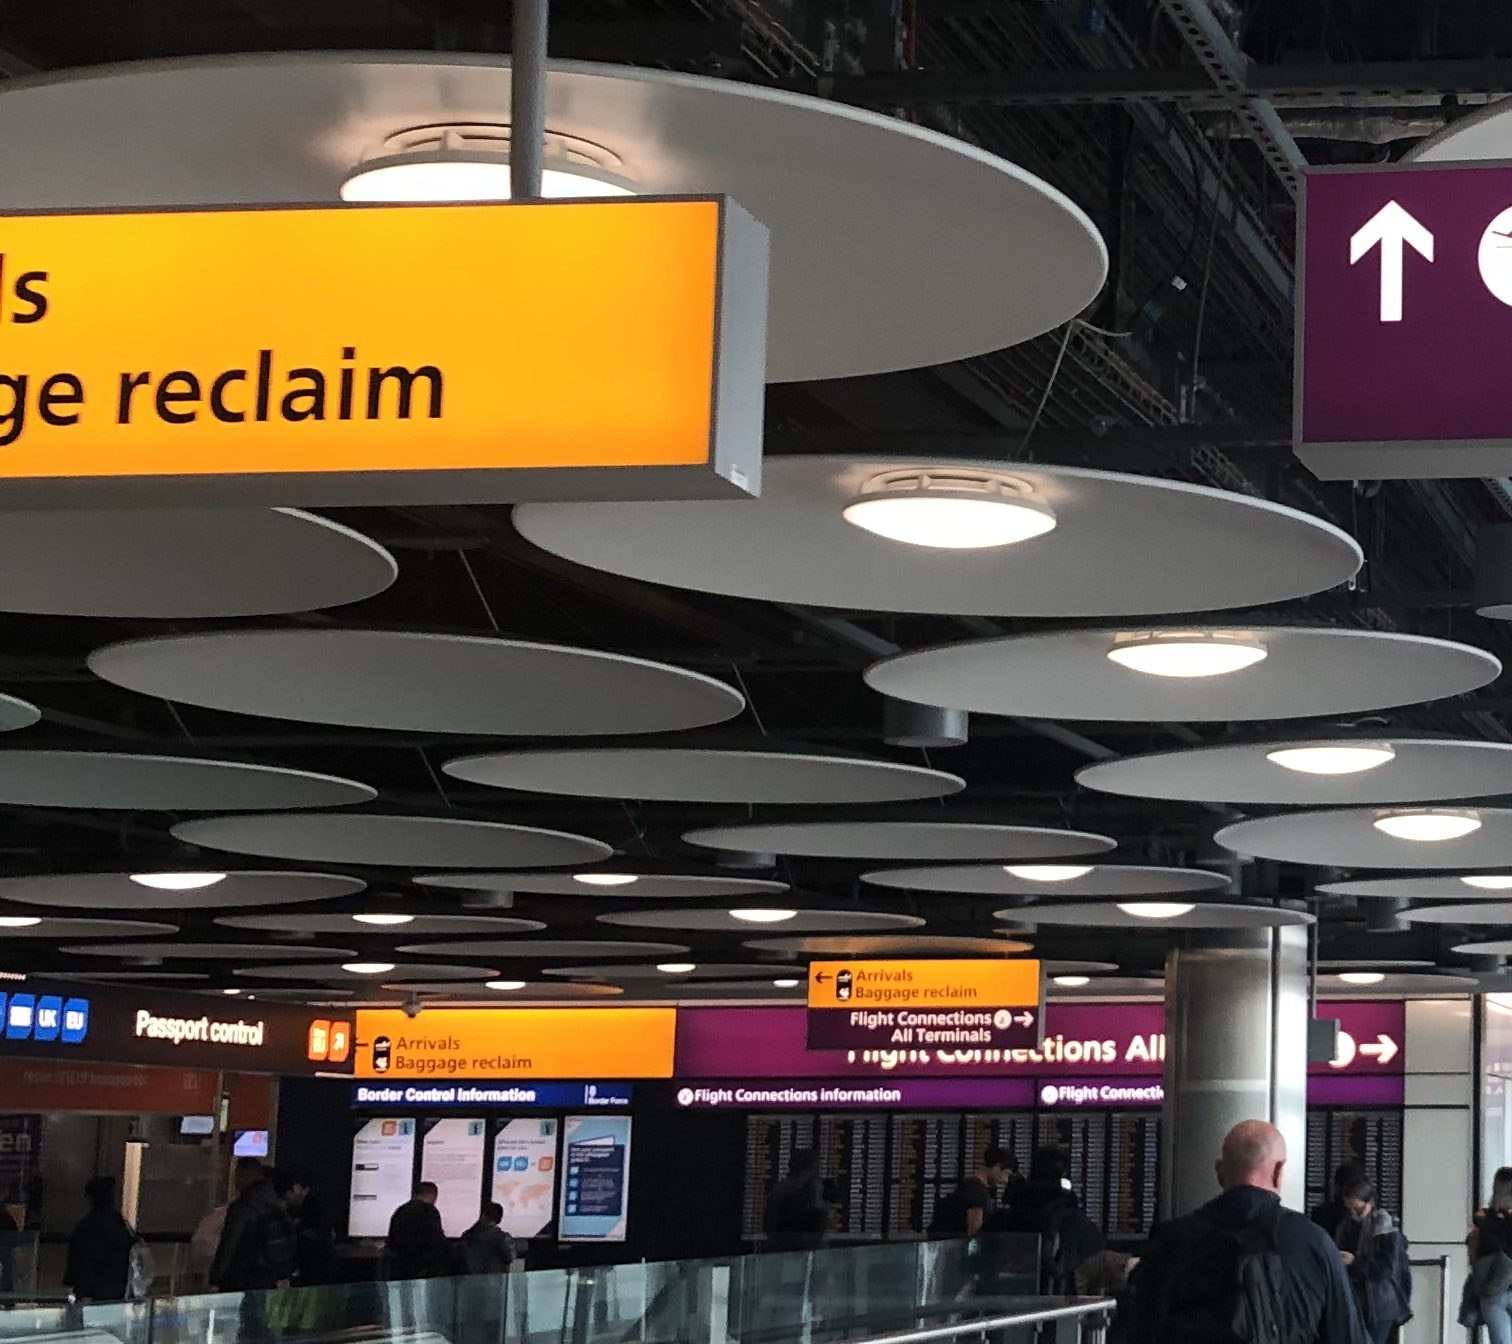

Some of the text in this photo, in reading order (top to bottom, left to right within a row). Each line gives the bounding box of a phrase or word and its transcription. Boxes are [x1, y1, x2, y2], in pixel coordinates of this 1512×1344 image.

[117, 346, 445, 425] reclaim
[856, 969, 913, 982] Arrivals
[855, 984, 978, 1002] Baggage reclaim
[39, 1008, 57, 1028] UK
[66, 1010, 84, 1031] EU
[136, 1009, 264, 1046] Passport control
[850, 1010, 992, 1030] Flight Connections
[395, 1036, 460, 1051] Arrivals
[890, 1027, 992, 1043] All Terminals
[1124, 1033, 1166, 1063] All
[395, 1055, 533, 1074] Baggage reclaim
[357, 1087, 404, 1102] Border
[405, 1087, 456, 1102] Control
[694, 1087, 902, 1105] Flight Connections information
[1059, 1085, 1099, 1104] Flight
